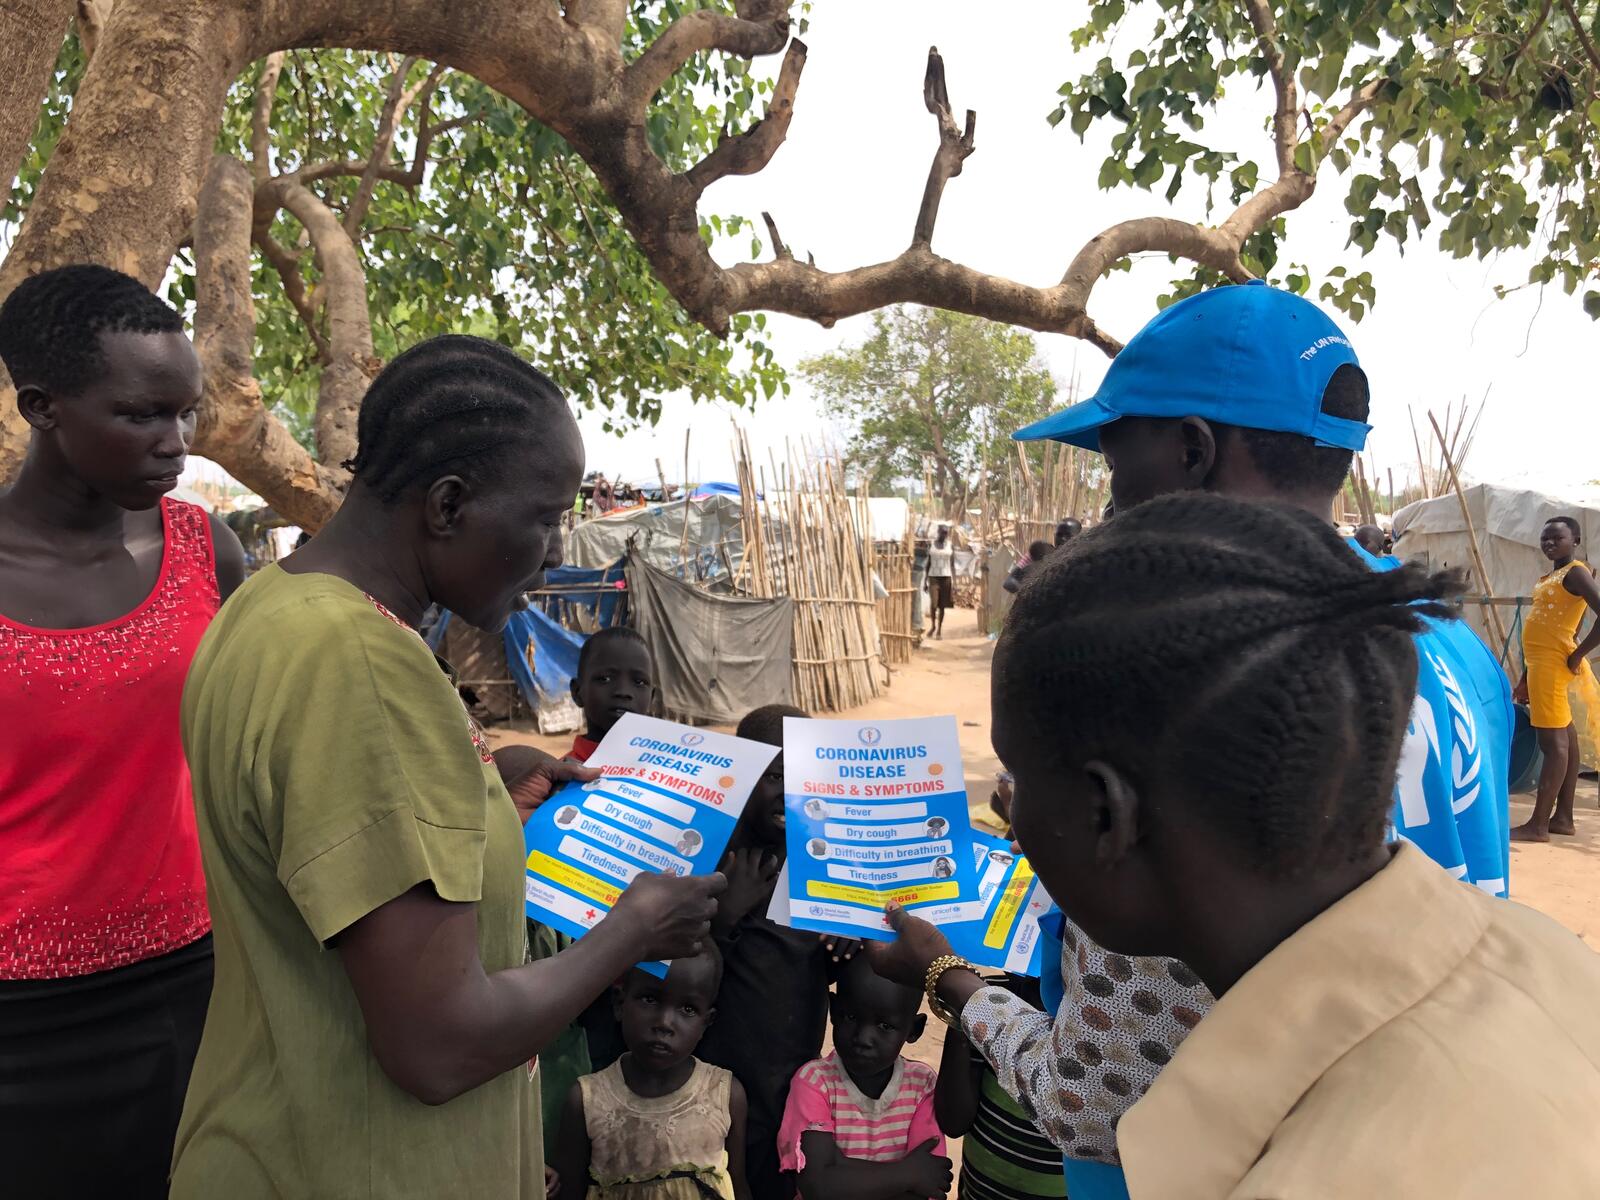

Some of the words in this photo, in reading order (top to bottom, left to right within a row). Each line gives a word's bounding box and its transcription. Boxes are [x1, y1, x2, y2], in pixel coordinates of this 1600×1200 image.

[1300, 346, 1317, 360] The
[1314, 337, 1329, 349] UN
[629, 736, 734, 768] CORONAVIRUS
[815, 745, 927, 760] CORONAVIRUS
[638, 752, 703, 777] DISEASE
[839, 765, 906, 778] DISEASE
[600, 765, 635, 777] SIGNS
[636, 768, 646, 778] &
[648, 770, 725, 806] SYMPTOMS
[617, 784, 643, 799] Fever
[803, 781, 845, 795] SIGNS
[849, 784, 860, 796] &
[864, 780, 945, 796] SYMPTOMS
[605, 803, 621, 818] Dry
[622, 812, 653, 831] cough
[845, 807, 872, 816] Fever
[846, 828, 864, 839] Dry
[866, 828, 897, 839] cough
[580, 820, 625, 848] Difficulty
[626, 840, 637, 852] in
[638, 846, 685, 876] breathing
[834, 847, 881, 861] Difficulty
[884, 849, 893, 859] in
[897, 845, 946, 859] breathing
[582, 848, 628, 877] Tiredness
[849, 869, 898, 881] Tiredness
[932, 906, 951, 915] unicef
